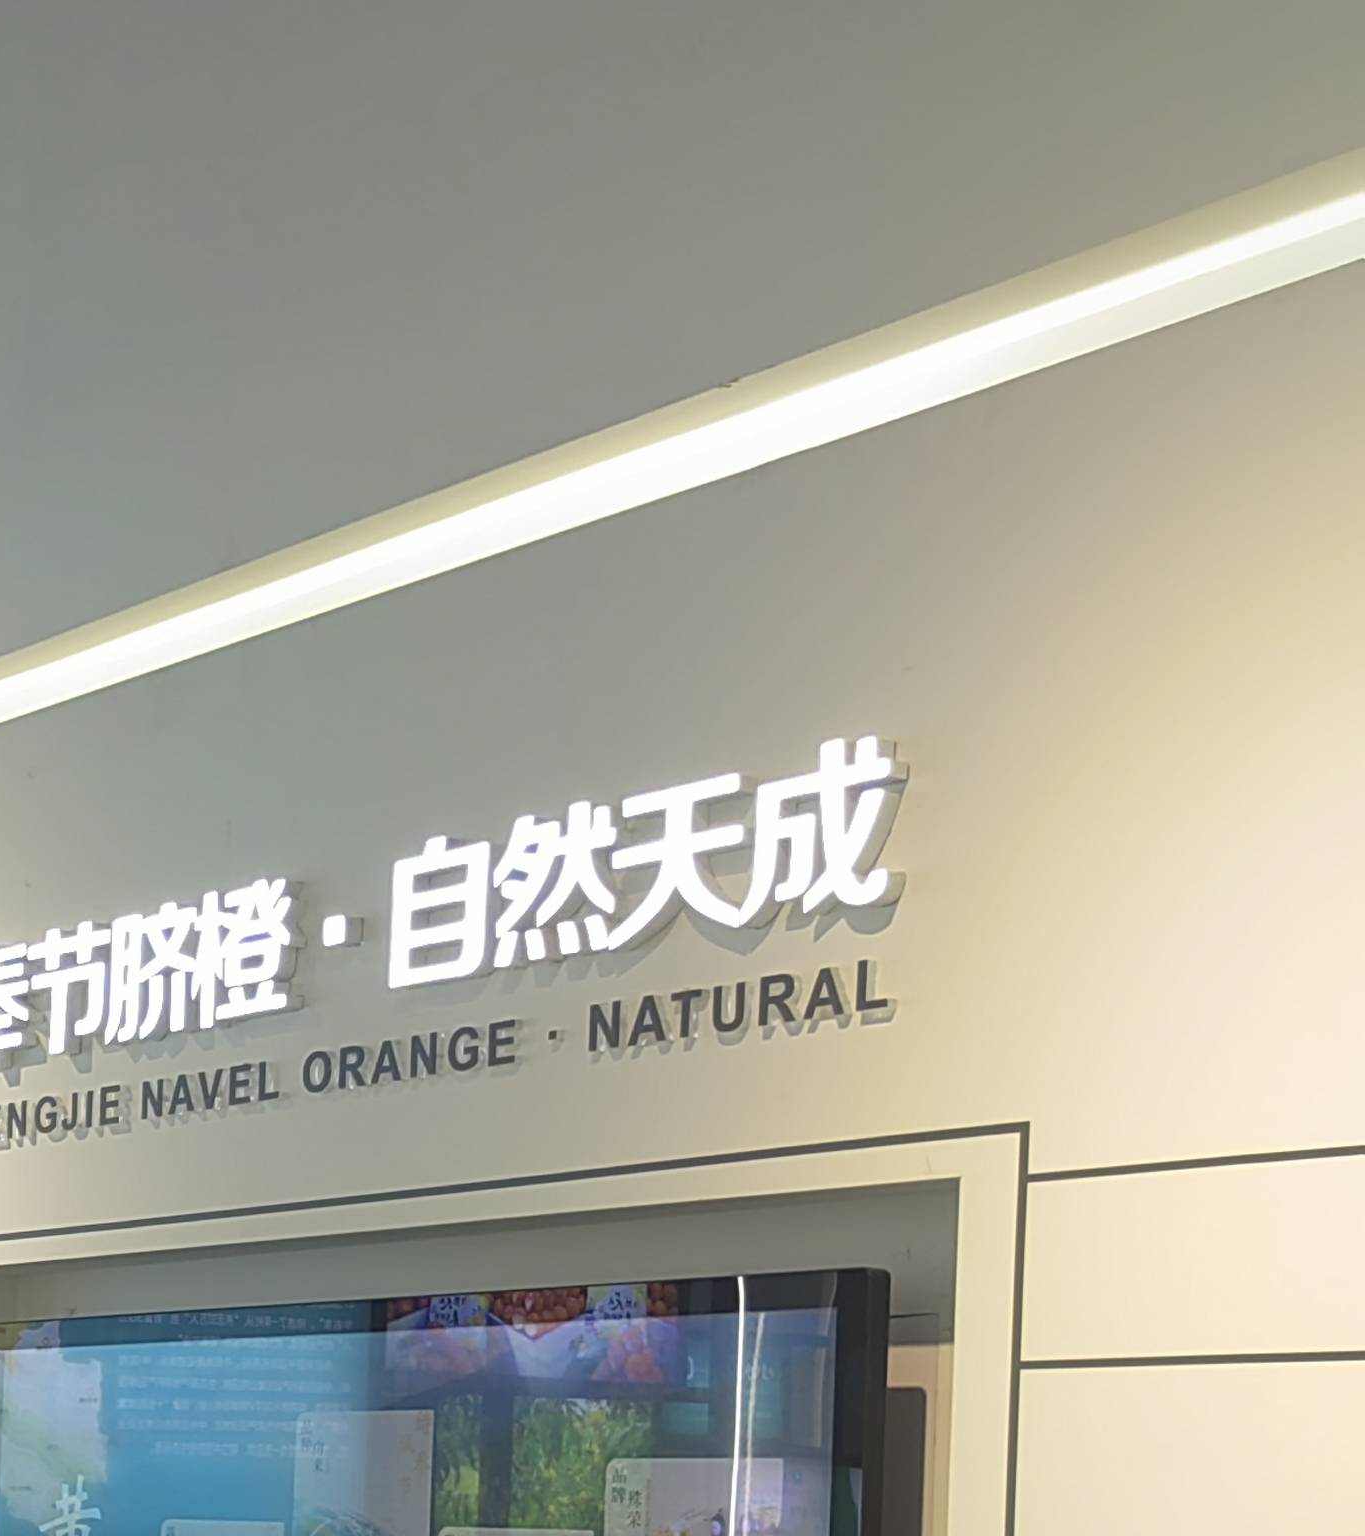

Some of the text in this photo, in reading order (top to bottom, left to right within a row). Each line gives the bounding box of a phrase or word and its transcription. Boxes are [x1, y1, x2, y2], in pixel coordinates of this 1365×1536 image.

[140, 1062, 280, 1118] NAVEL
[301, 1019, 516, 1094] ORANGE
[587, 959, 889, 1053] NATURAL
